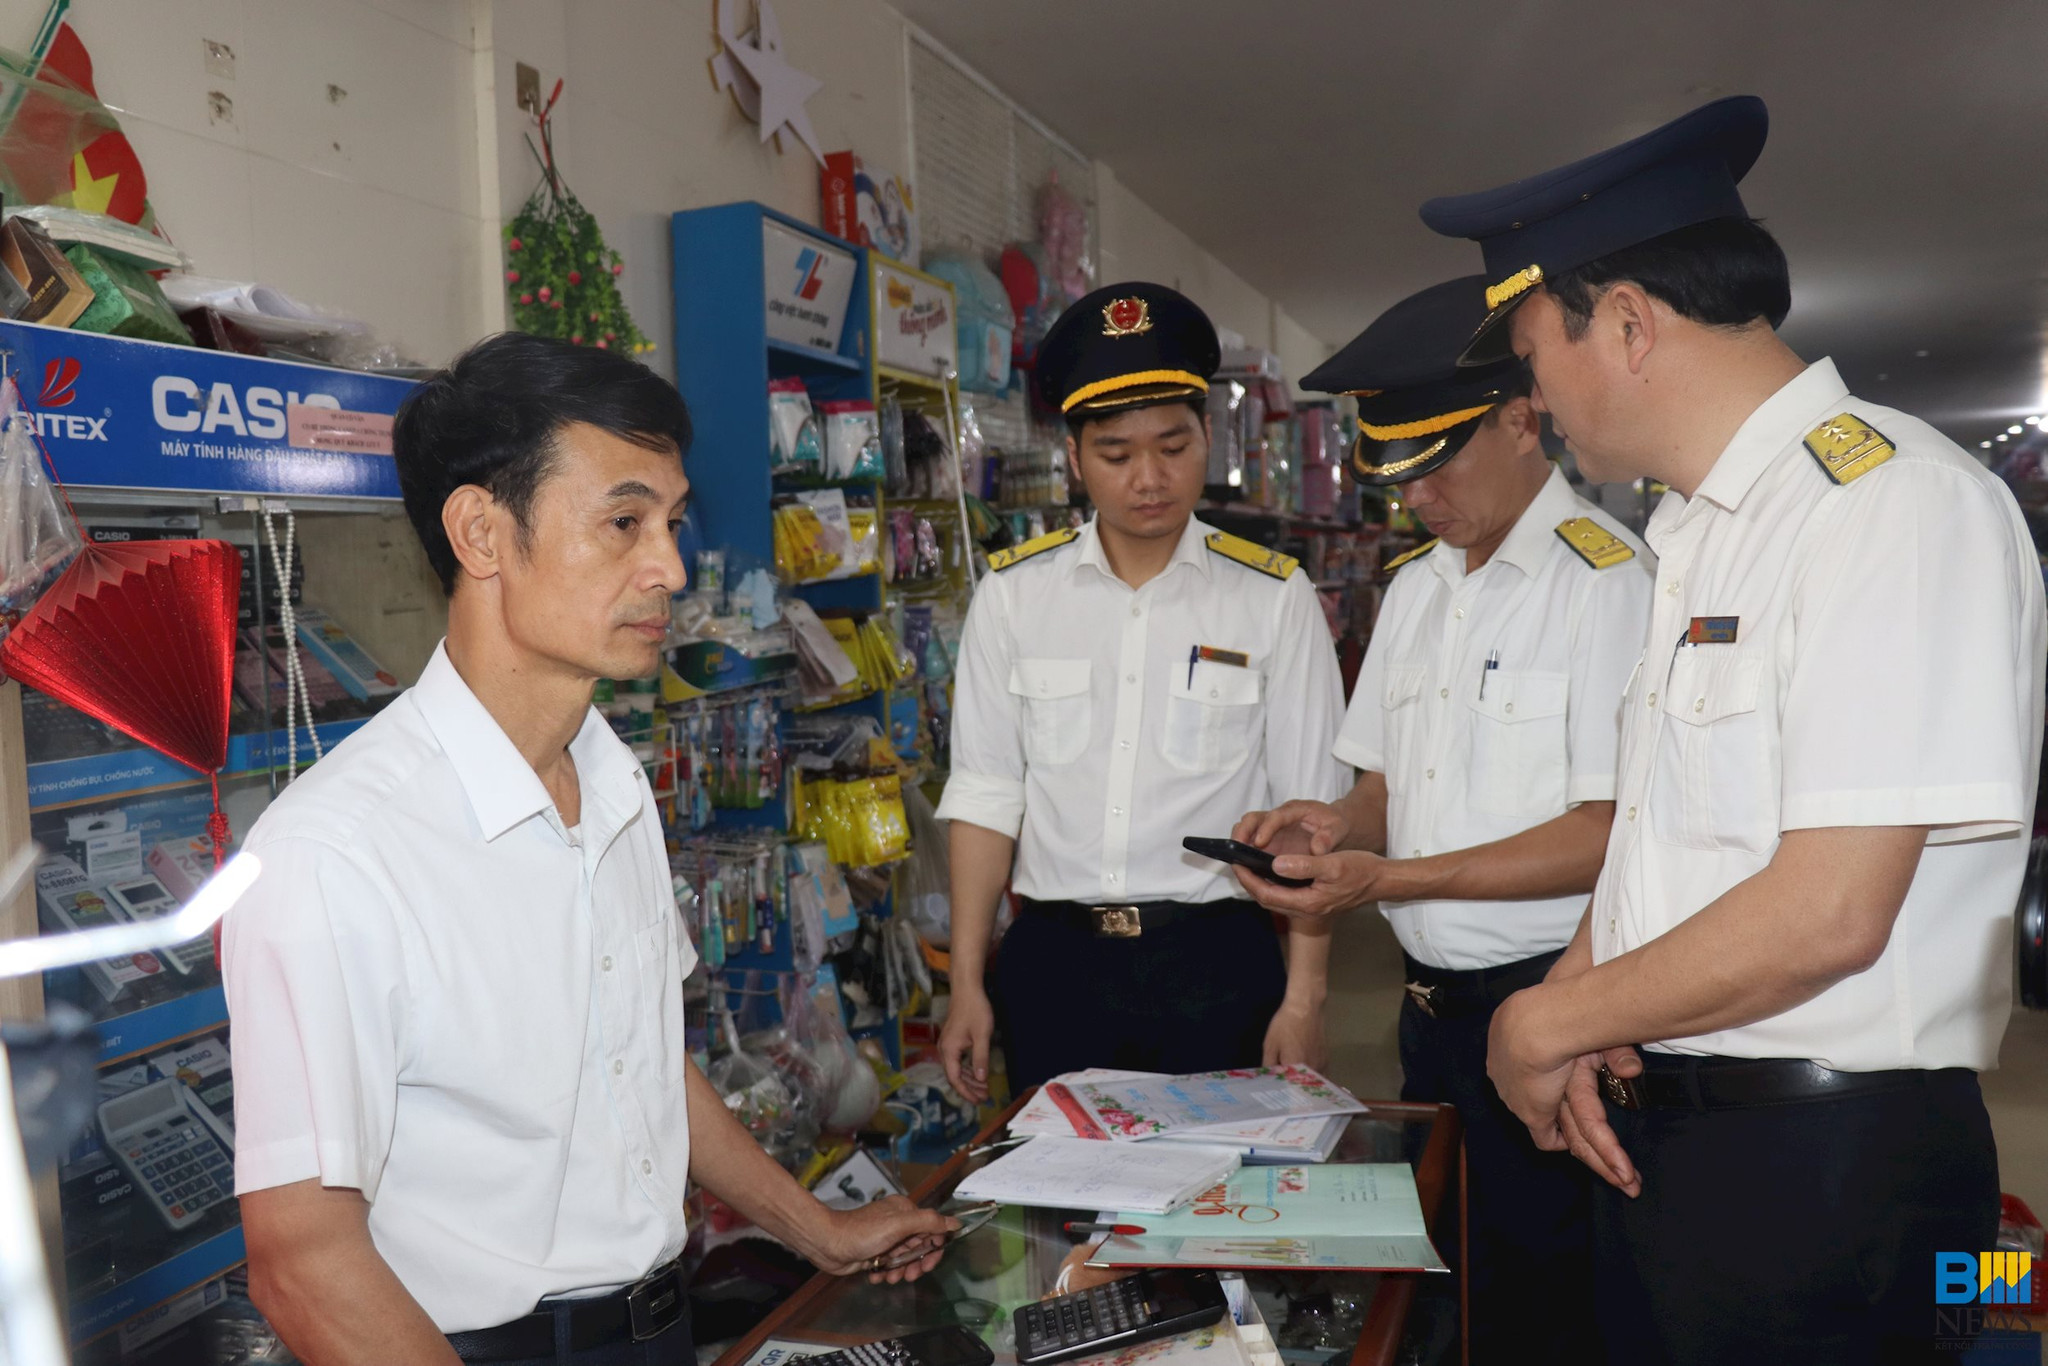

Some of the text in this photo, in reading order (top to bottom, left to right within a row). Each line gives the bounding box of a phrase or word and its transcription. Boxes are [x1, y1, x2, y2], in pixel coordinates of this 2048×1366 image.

[152, 375, 341, 439] CAS
[161, 439, 190, 457] MÁY
[193, 440, 224, 459] TÍNH
[227, 444, 263, 462] HÀNG
[94, 531, 130, 541] CASIO
[40, 867, 73, 880] CASIO
[176, 1048, 213, 1068] CASIO
